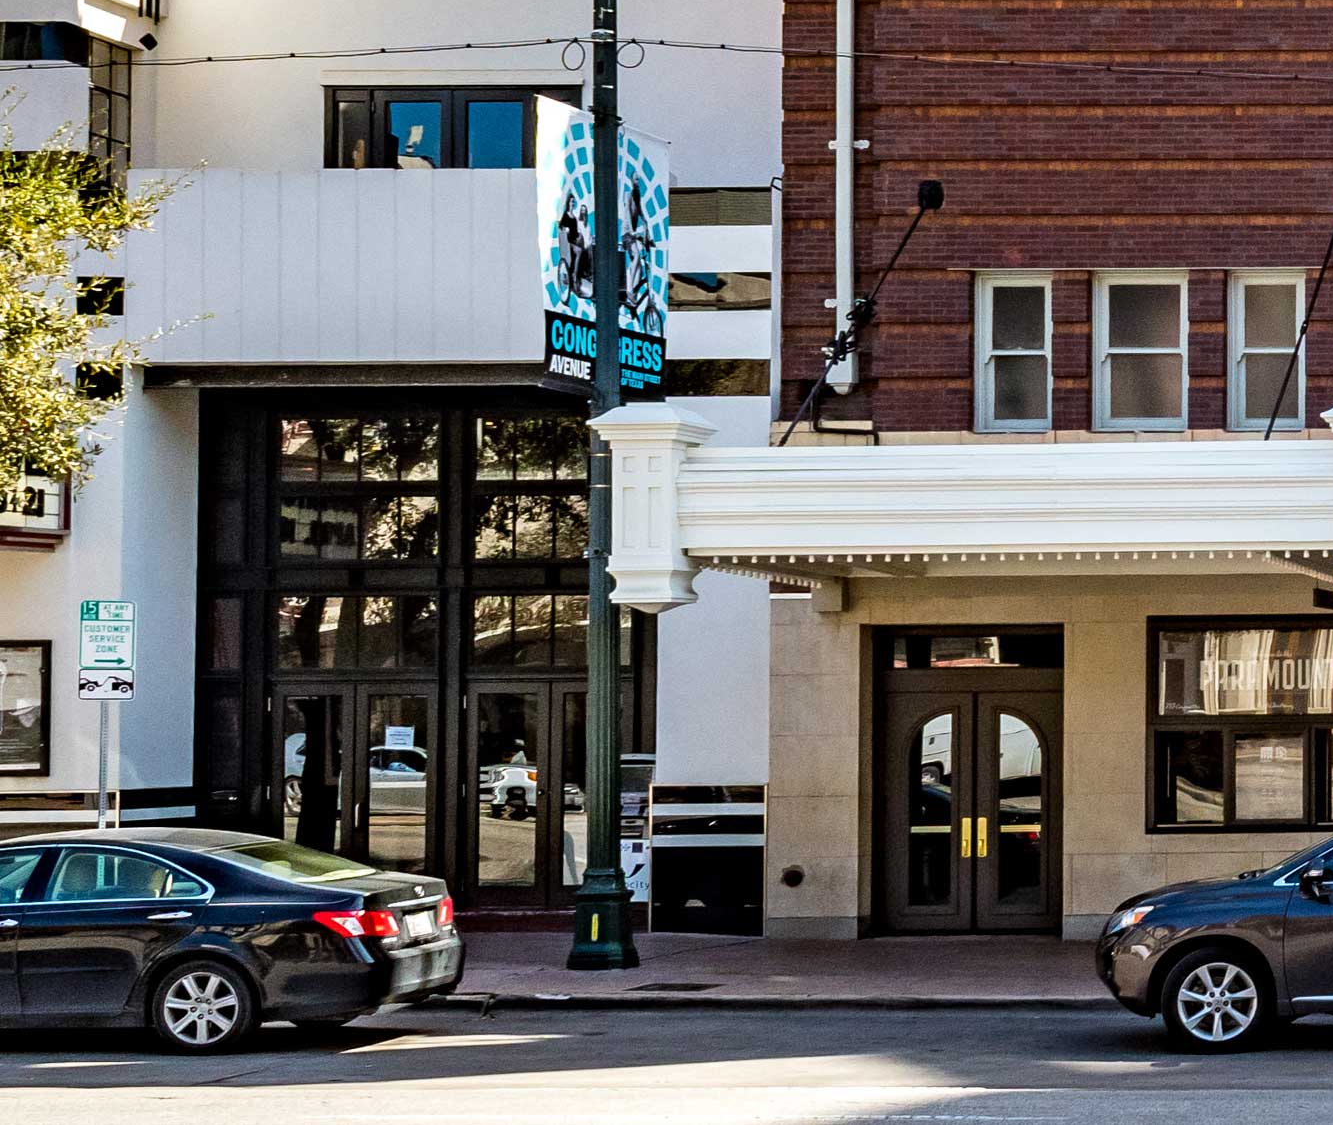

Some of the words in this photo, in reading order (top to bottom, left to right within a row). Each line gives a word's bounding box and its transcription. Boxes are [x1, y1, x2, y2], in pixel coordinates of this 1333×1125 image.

[549, 354, 592, 380] AVENUE
[83, 601, 97, 614] 15
[84, 625, 130, 633] CUSTOMER
[88, 635, 126, 643] SERVICE
[95, 645, 118, 653] ZONE
